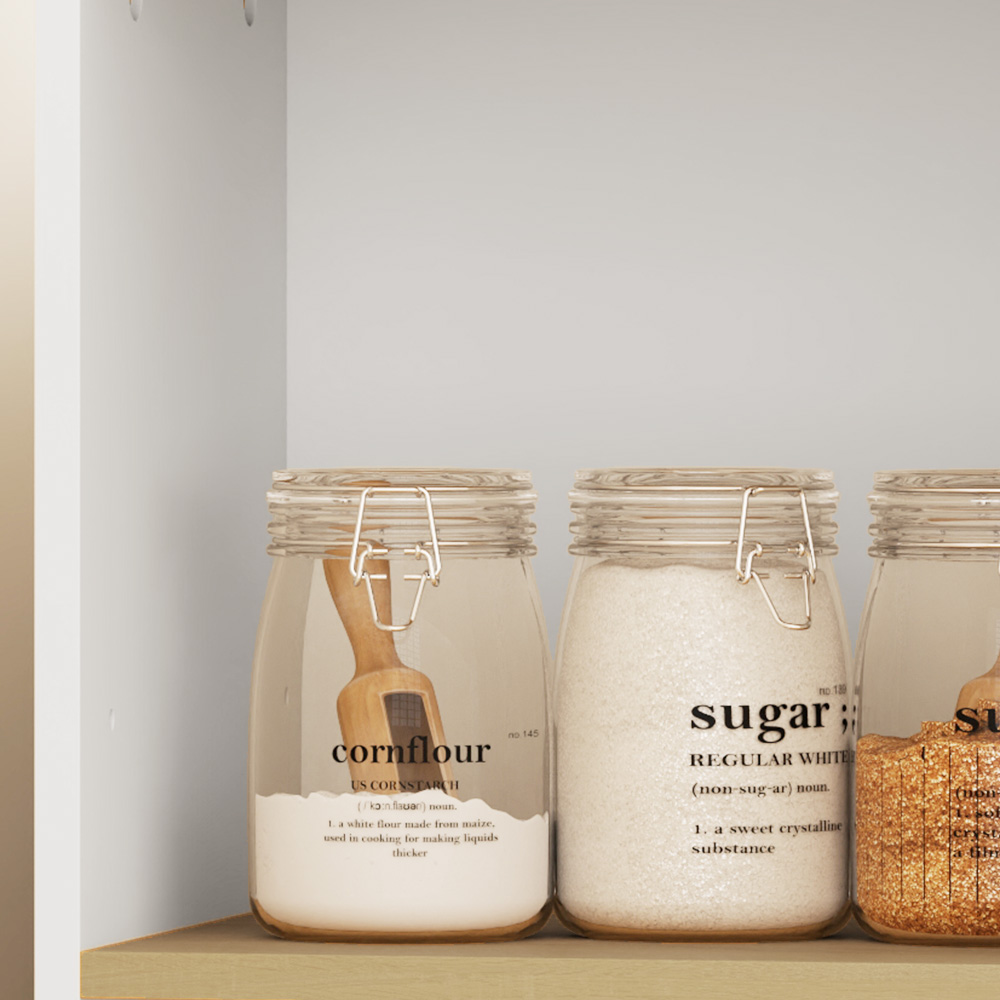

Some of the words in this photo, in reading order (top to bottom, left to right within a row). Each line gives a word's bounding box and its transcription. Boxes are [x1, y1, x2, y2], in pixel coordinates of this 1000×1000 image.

[691, 702, 830, 743] sugar
[842, 704, 848, 735] ;
[332, 736, 491, 764] cornflour
[690, 753, 792, 766] REGULAR
[799, 750, 849, 766] WHITE
[351, 780, 366, 791] US
[370, 780, 459, 792] CORNSTARCH
[691, 782, 792, 798] (non-sug-ar)
[797, 783, 830, 793] noun.
[429, 803, 457, 811] noun.
[347, 820, 375, 829] white
[377, 819, 401, 829] flour
[404, 820, 431, 829] made
[434, 820, 459, 829] from
[695, 824, 707, 834] 1.
[714, 826, 723, 834] a
[730, 824, 774, 834] sweet
[779, 820, 843, 837] crystalline
[324, 833, 346, 843] used
[349, 833, 358, 842] in
[361, 834, 402, 845] cooking
[405, 833, 419, 843] for
[422, 833, 460, 845] making
[464, 833, 499, 845] liquids
[392, 848, 428, 858] thicker
[692, 842, 775, 854] substance
